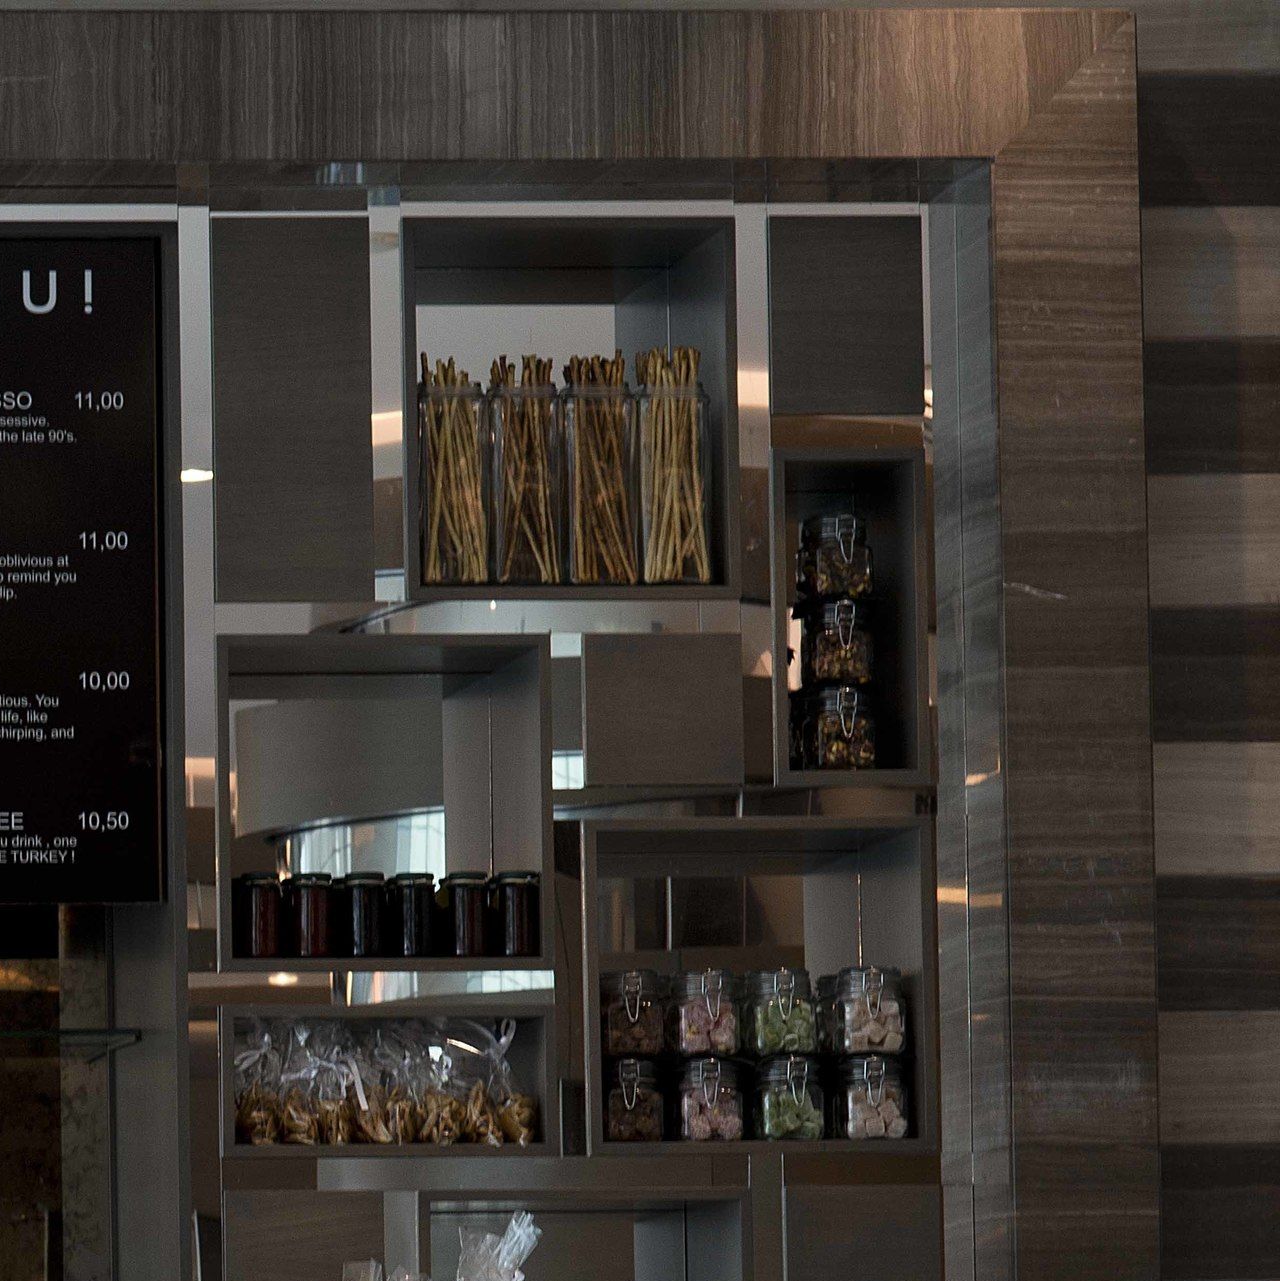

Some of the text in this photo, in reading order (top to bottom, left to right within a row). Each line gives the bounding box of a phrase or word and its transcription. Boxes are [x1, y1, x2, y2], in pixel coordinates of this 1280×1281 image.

[75, 392, 124, 411] 11,00
[80, 532, 128, 551] 11,00
[80, 672, 129, 691] 10,00
[36, 695, 59, 707] You
[27, 710, 48, 722] like
[51, 726, 74, 738] and
[79, 812, 129, 831] 10,50
